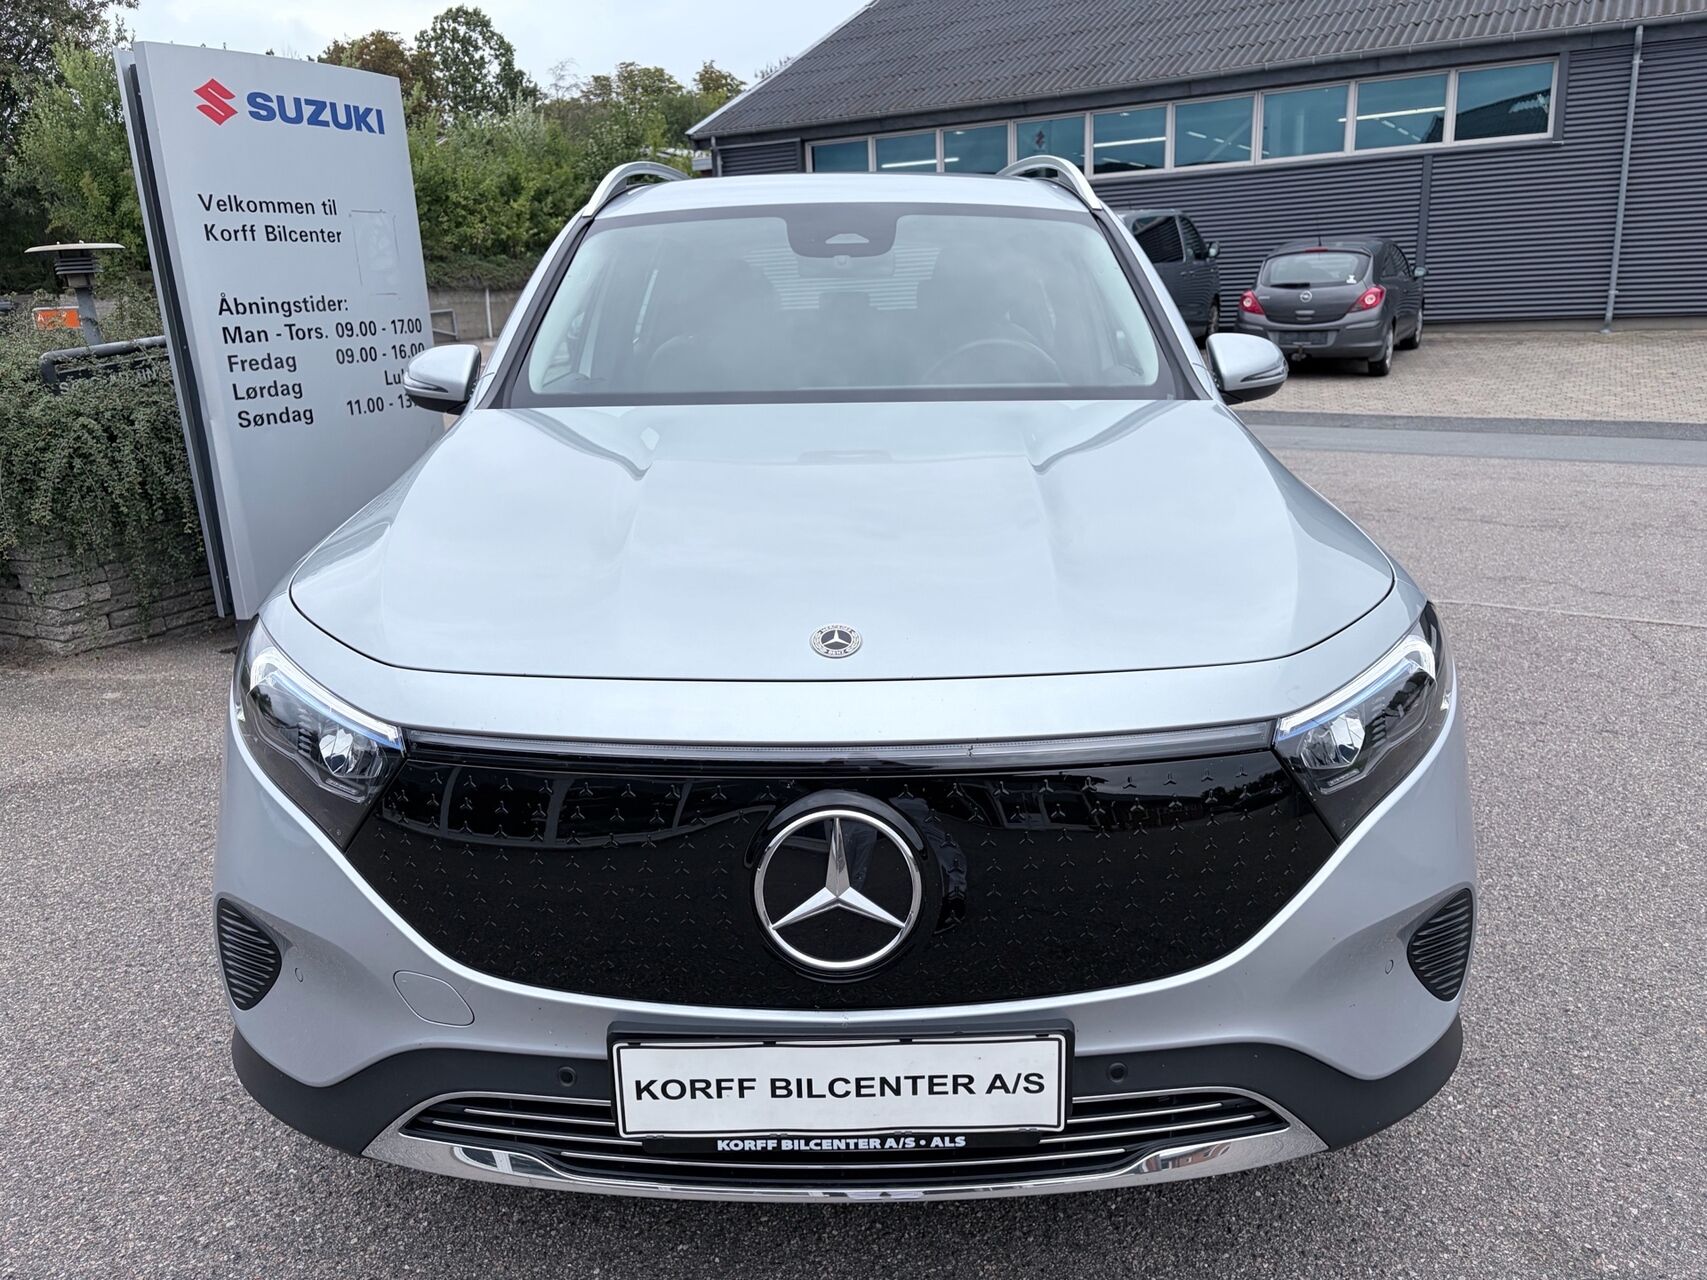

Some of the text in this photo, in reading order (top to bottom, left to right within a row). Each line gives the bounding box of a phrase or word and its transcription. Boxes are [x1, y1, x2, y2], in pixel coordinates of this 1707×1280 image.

[246, 91, 386, 135] SUZUKI
[197, 193, 338, 216] Velkommen til
[203, 223, 342, 243] Korff Bilcenter
[218, 292, 349, 318] Åbningstider:
[221, 325, 269, 344] Man
[283, 323, 329, 341] Tors.
[335, 320, 377, 339] 09.00
[390, 317, 423, 335] 17.00
[227, 352, 297, 373] Fredag
[335, 346, 378, 365] 09.00
[232, 379, 303, 401] Lørdag
[237, 406, 314, 428] Søndag
[346, 396, 385, 416] 11.00
[635, 1072, 1046, 1101] KORFF BILCENTER A/S
[717, 1136, 967, 1151] KORFF BILCENTER A/S ALS
